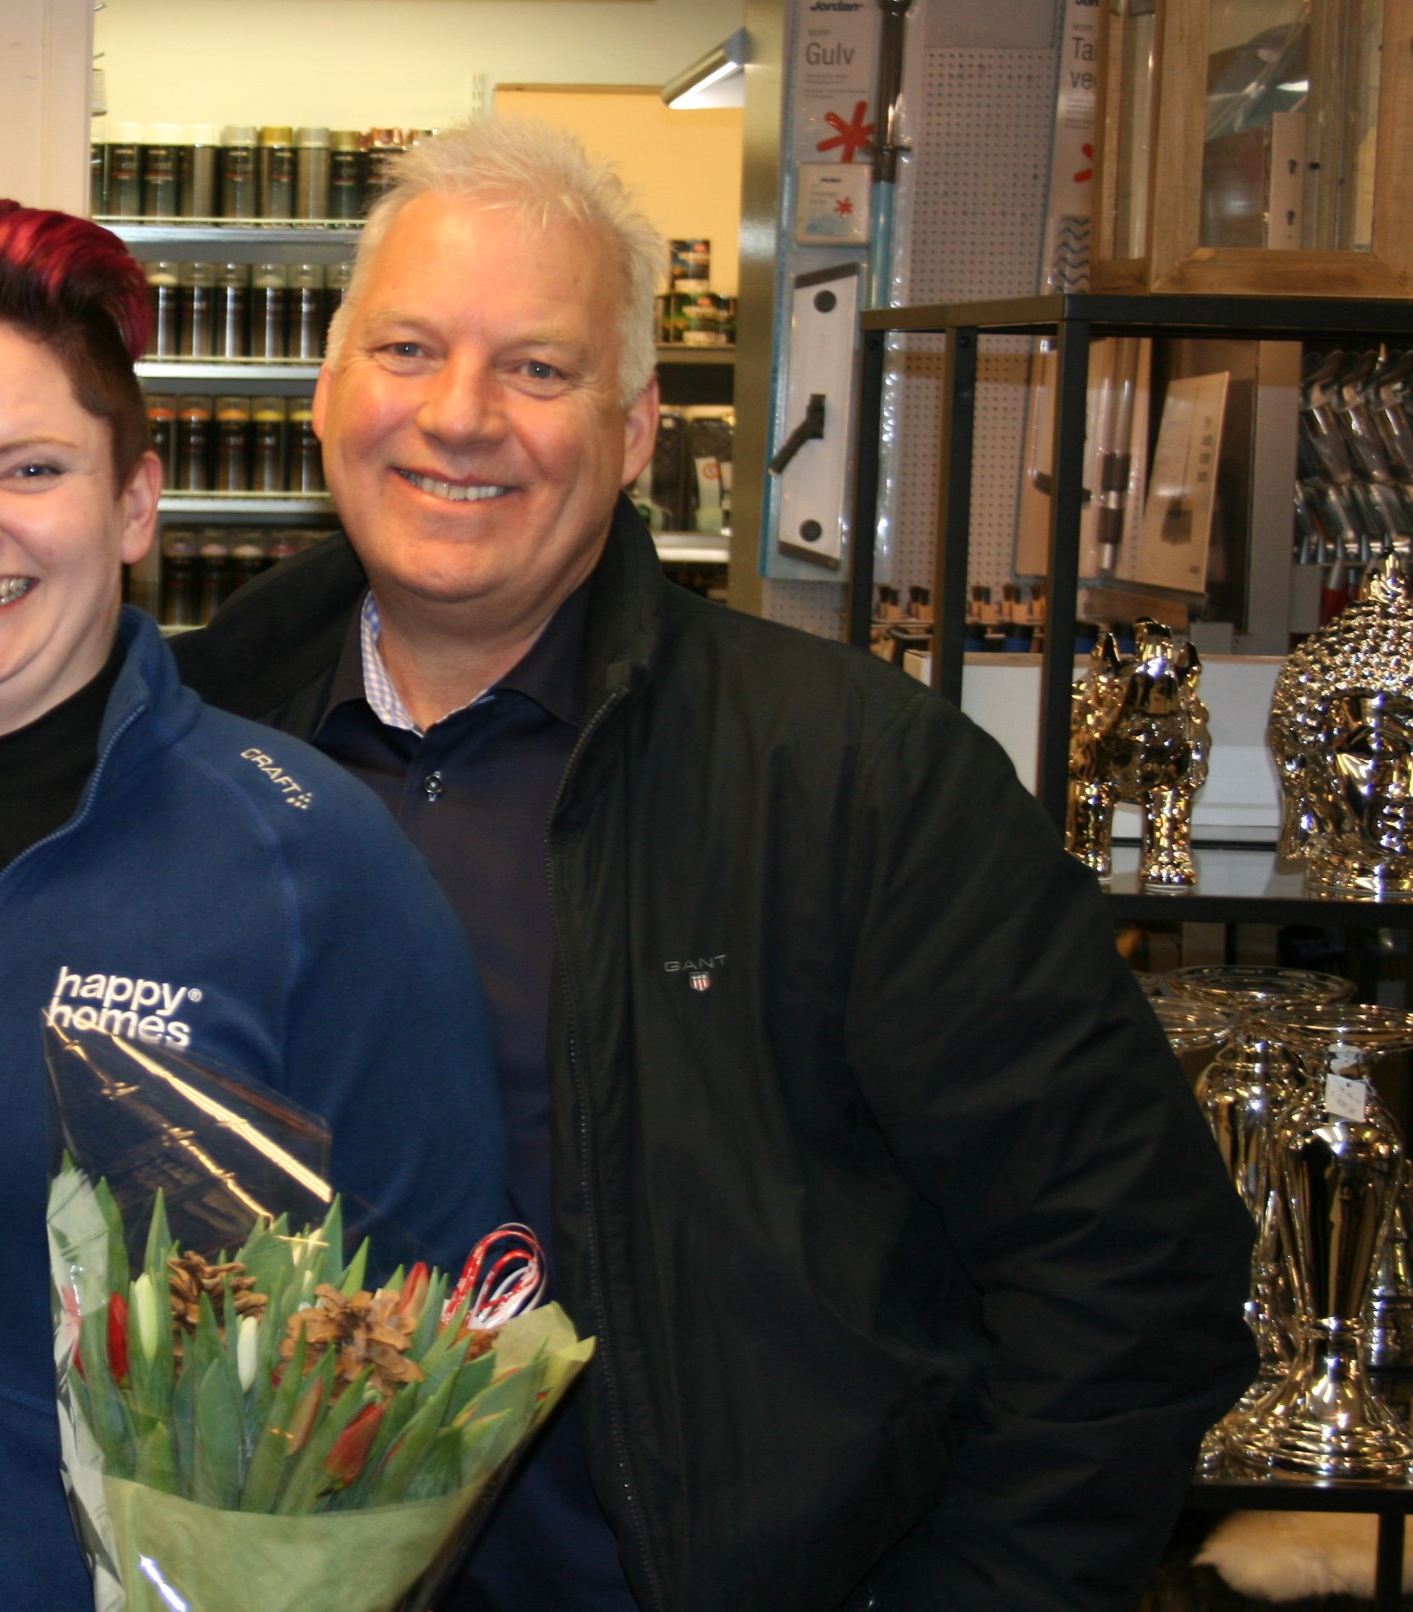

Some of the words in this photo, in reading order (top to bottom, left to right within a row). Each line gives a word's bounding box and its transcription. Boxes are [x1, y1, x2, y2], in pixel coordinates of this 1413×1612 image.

[806, 42, 855, 65] Gulv
[1071, 37, 1094, 61] Ta
[1070, 71, 1094, 90] ve
[240, 747, 303, 793] CRAFT
[664, 953, 727, 972] GANT
[46, 996, 191, 1050] homes
